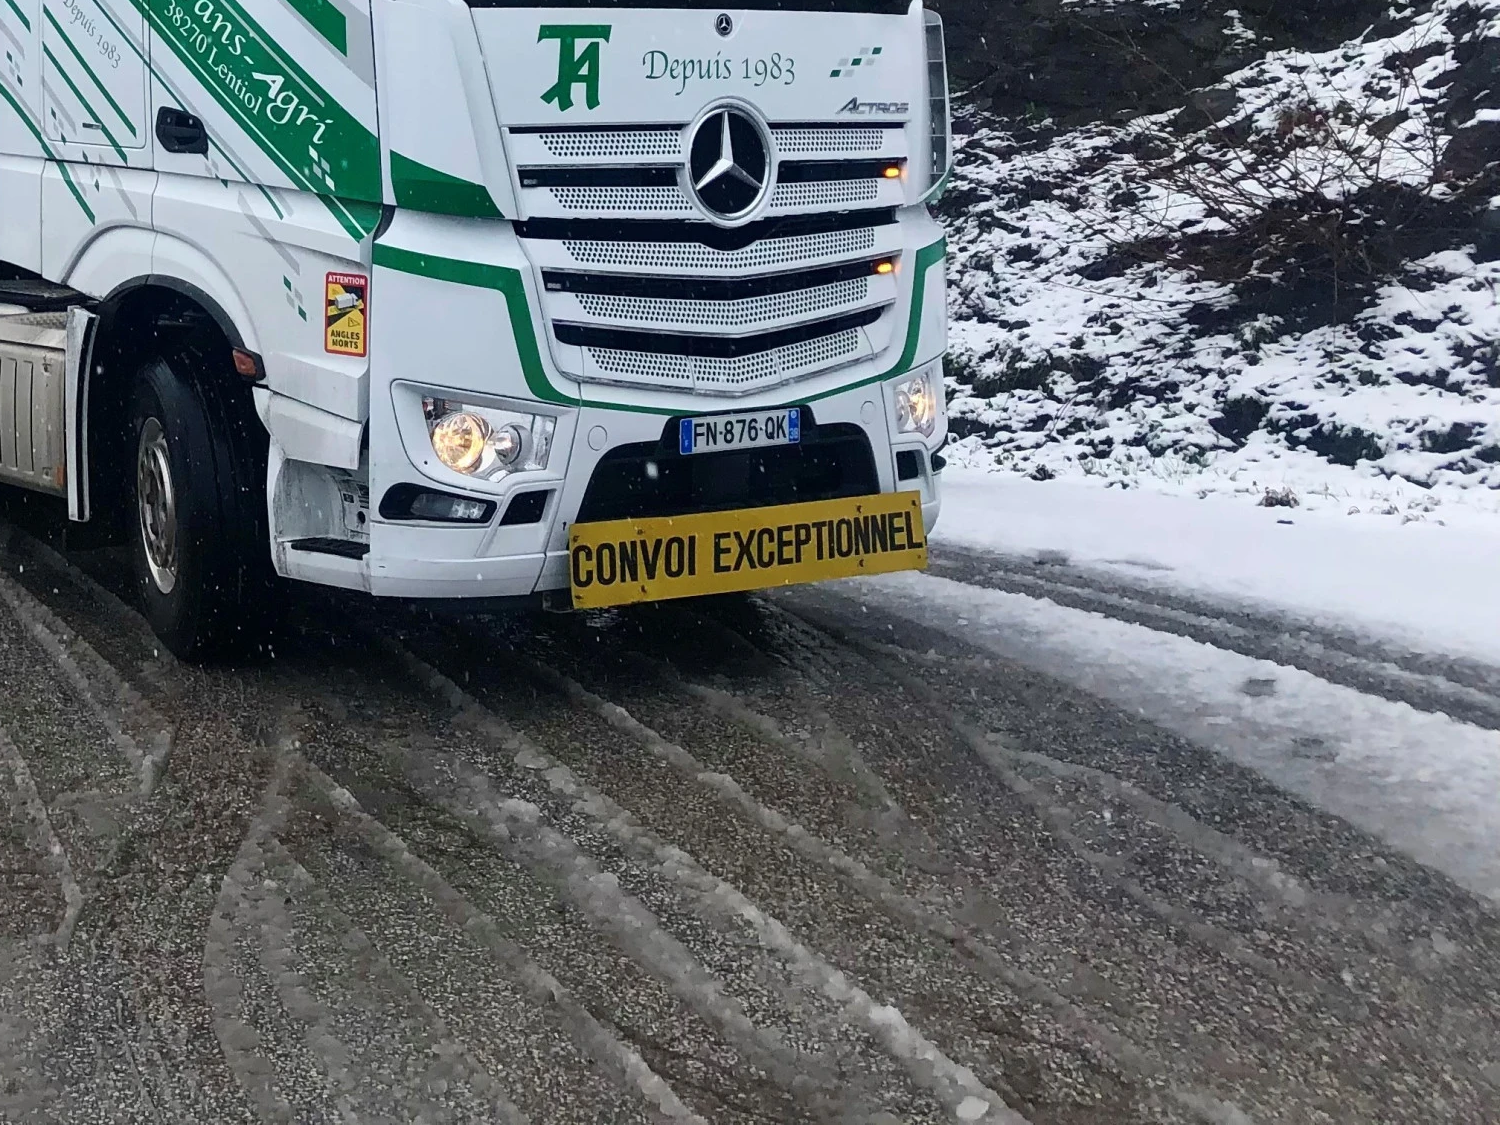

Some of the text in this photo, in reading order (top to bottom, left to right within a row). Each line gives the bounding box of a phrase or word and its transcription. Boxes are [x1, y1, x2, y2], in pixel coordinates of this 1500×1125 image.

[97, 34, 121, 68] 1983
[207, 45, 263, 115] Lentiol
[642, 49, 795, 96] Depuis 1983
[328, 275, 366, 286] ATTENTION
[330, 329, 360, 341] ANGLES
[332, 339, 359, 350] MORTS
[694, 415, 787, 448] FN-876-QK
[572, 511, 923, 588] CONVOI EXCEPTIONNEL
